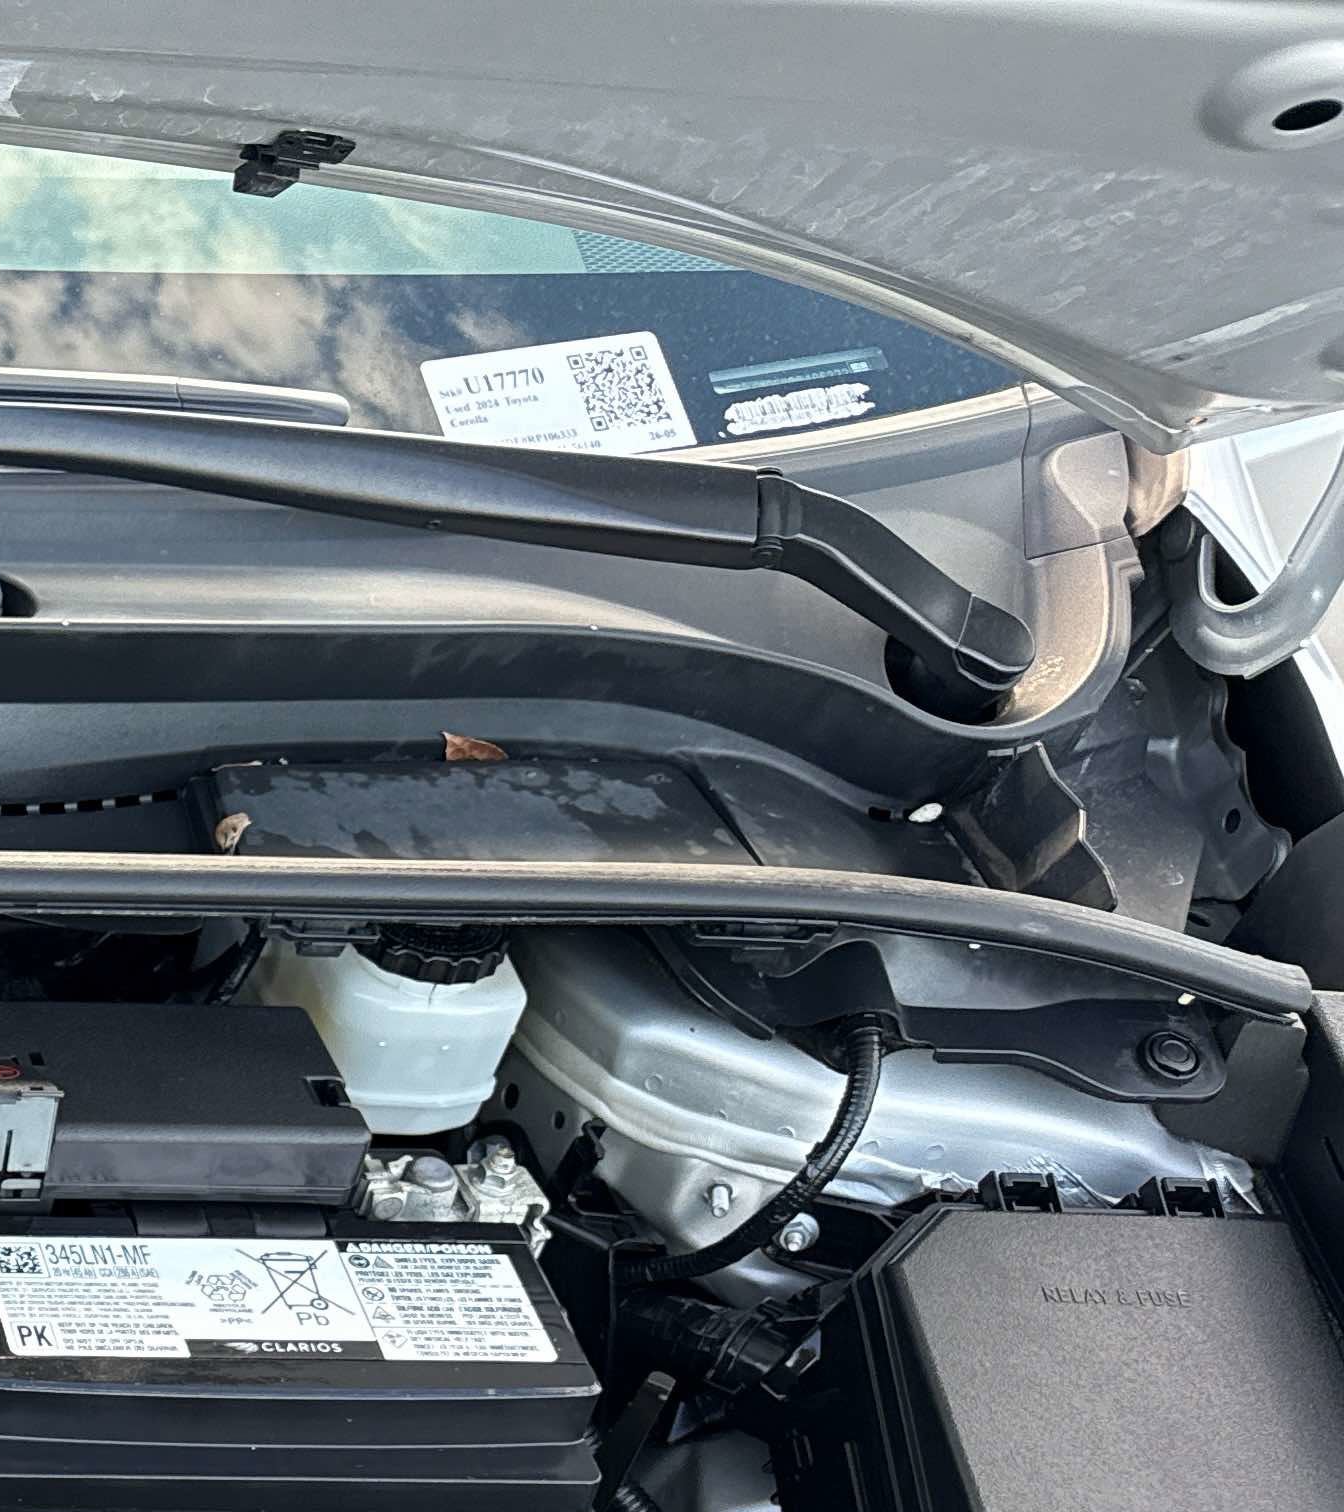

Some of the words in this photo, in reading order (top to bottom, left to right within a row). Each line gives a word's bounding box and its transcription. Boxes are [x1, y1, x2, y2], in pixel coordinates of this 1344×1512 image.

[462, 366, 545, 395] U17770
[44, 1244, 151, 1265] 345LN1-MF
[1041, 1285, 1107, 1304] RELAY
[1117, 1289, 1133, 1304] &
[1135, 1289, 1192, 1307] FUSE
[296, 1311, 330, 1326] Pb
[17, 1325, 52, 1347] PK
[261, 1342, 343, 1353] CLARIOS
